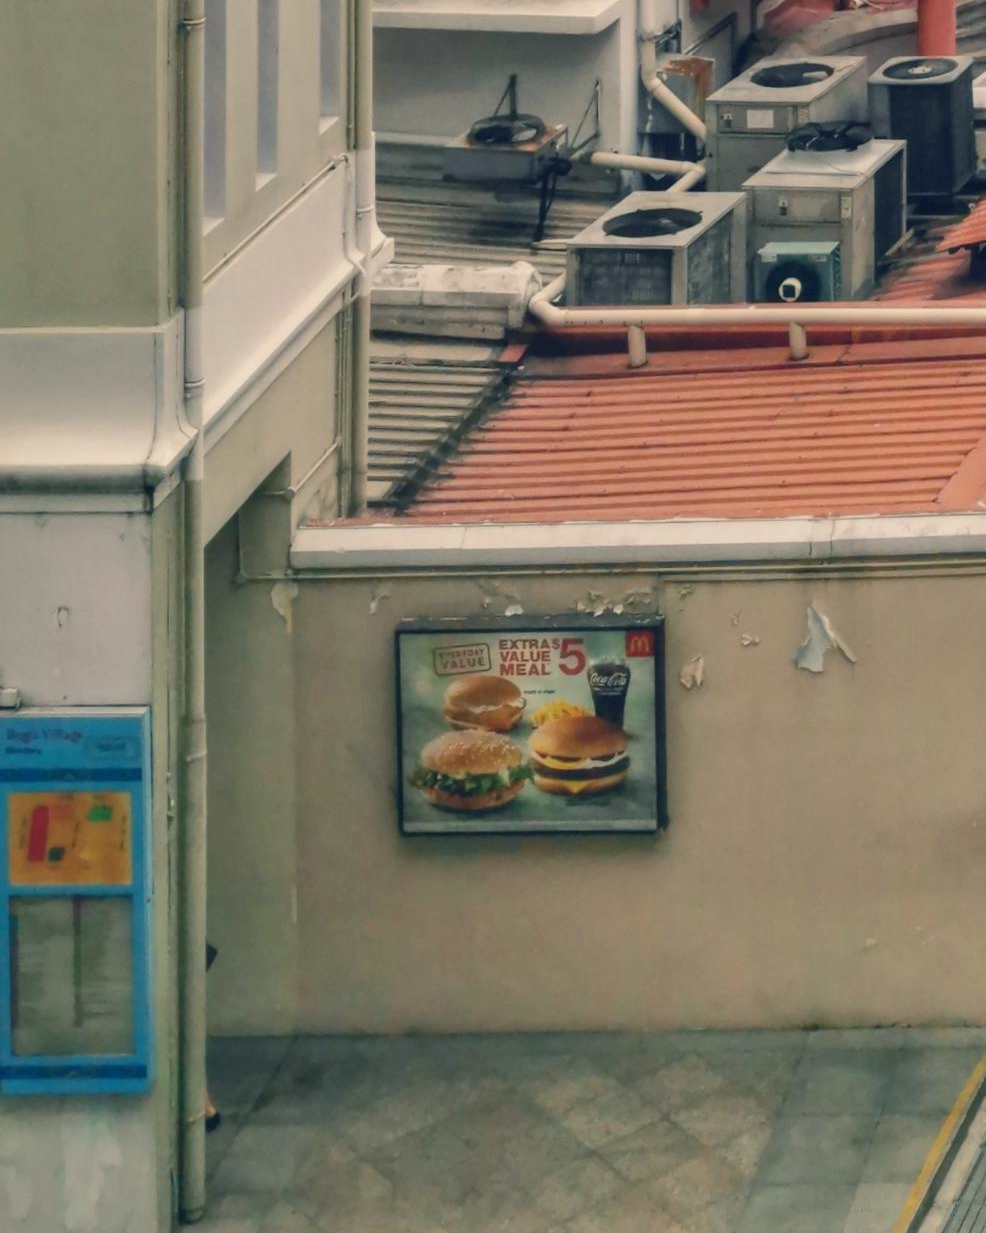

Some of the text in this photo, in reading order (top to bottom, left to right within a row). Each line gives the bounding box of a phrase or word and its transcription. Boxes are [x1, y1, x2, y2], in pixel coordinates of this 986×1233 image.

[499, 639, 550, 650] EXTRA
[499, 651, 550, 662] VALUE
[440, 657, 486, 670] VALUE
[499, 663, 550, 676] MEAL
